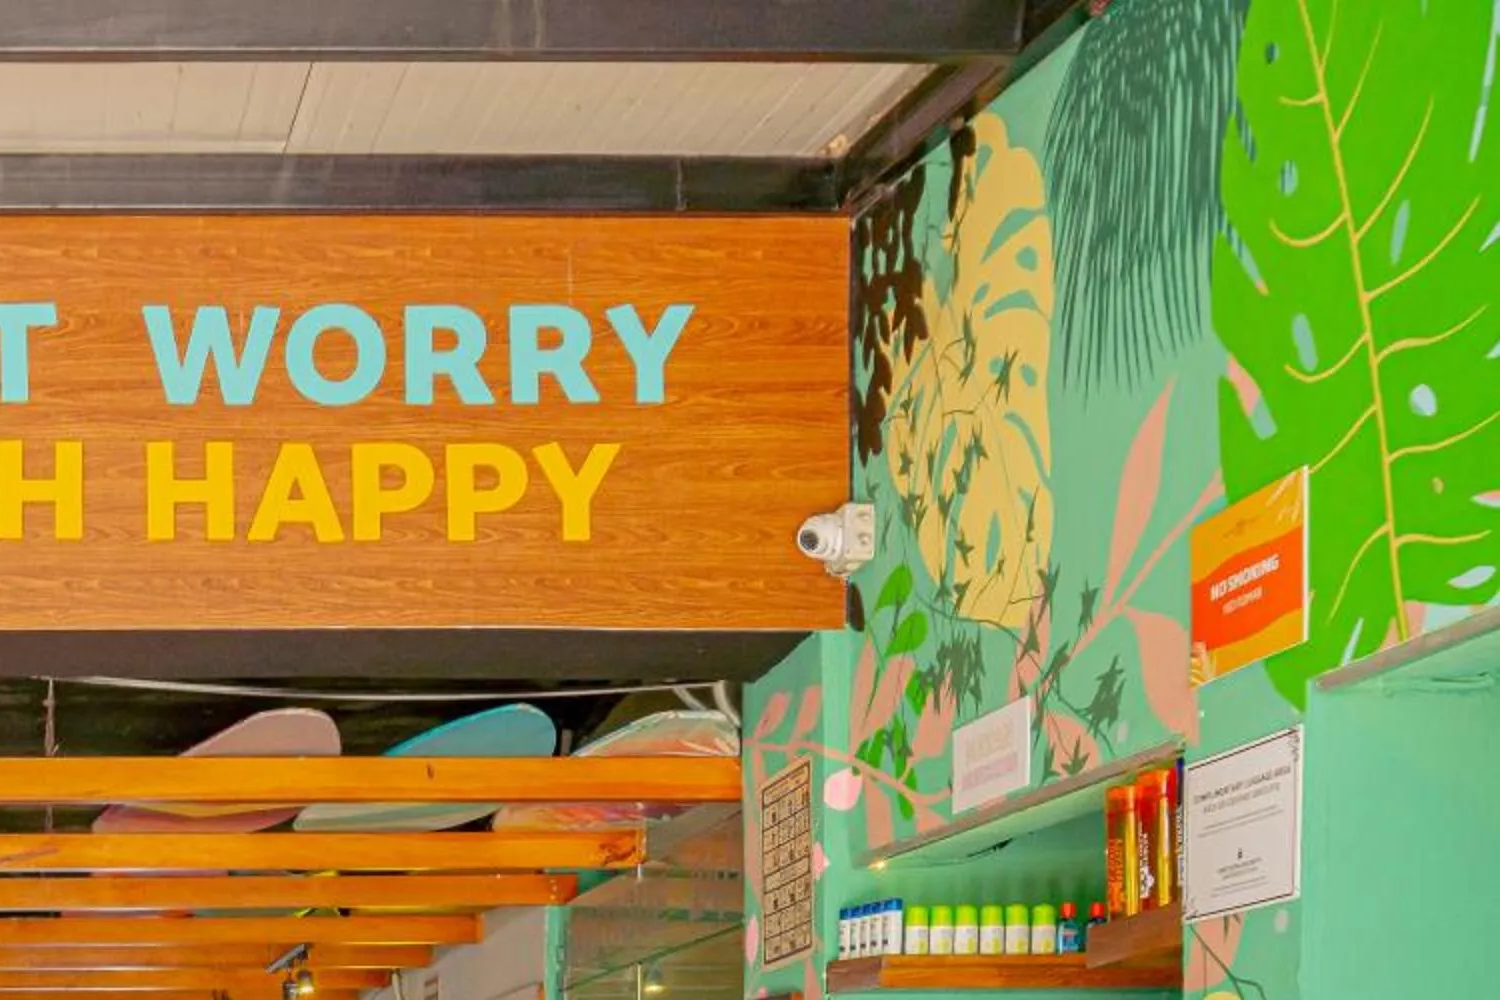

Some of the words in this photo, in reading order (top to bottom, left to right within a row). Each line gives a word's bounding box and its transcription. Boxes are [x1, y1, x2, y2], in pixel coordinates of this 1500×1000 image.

[143, 303, 691, 406] WORRY
[145, 440, 620, 543] HAPPY
[1227, 552, 1280, 594] SMOKING
